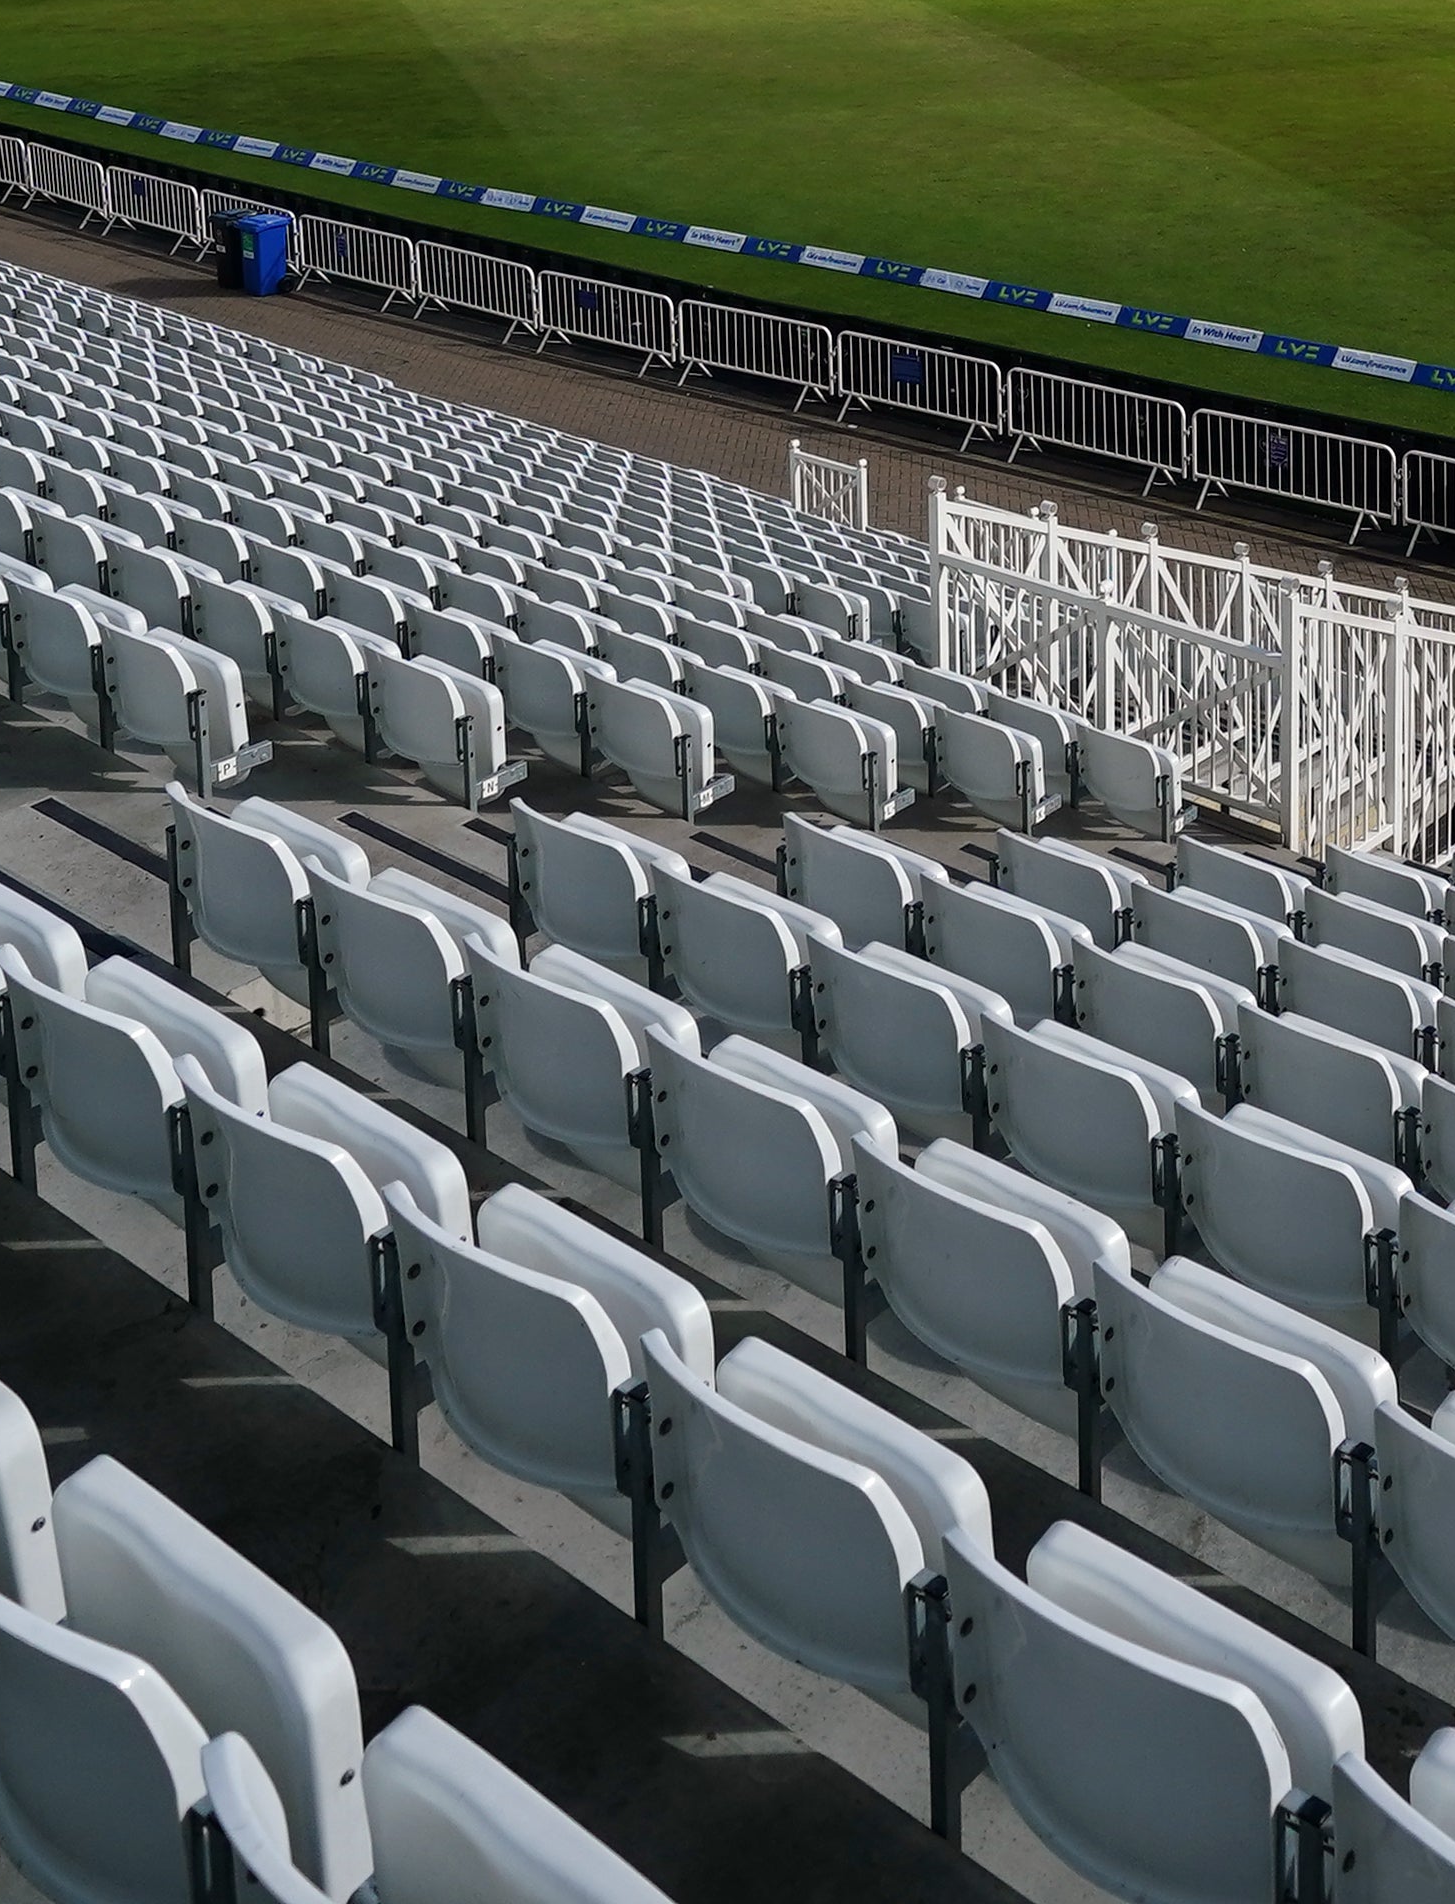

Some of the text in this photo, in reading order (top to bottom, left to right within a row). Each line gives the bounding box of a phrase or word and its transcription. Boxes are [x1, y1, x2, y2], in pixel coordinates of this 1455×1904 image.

[699, 232, 714, 242] With
[1192, 325, 1250, 344] In With Heart
[223, 764, 230, 775] P
[486, 782, 494, 793] N
